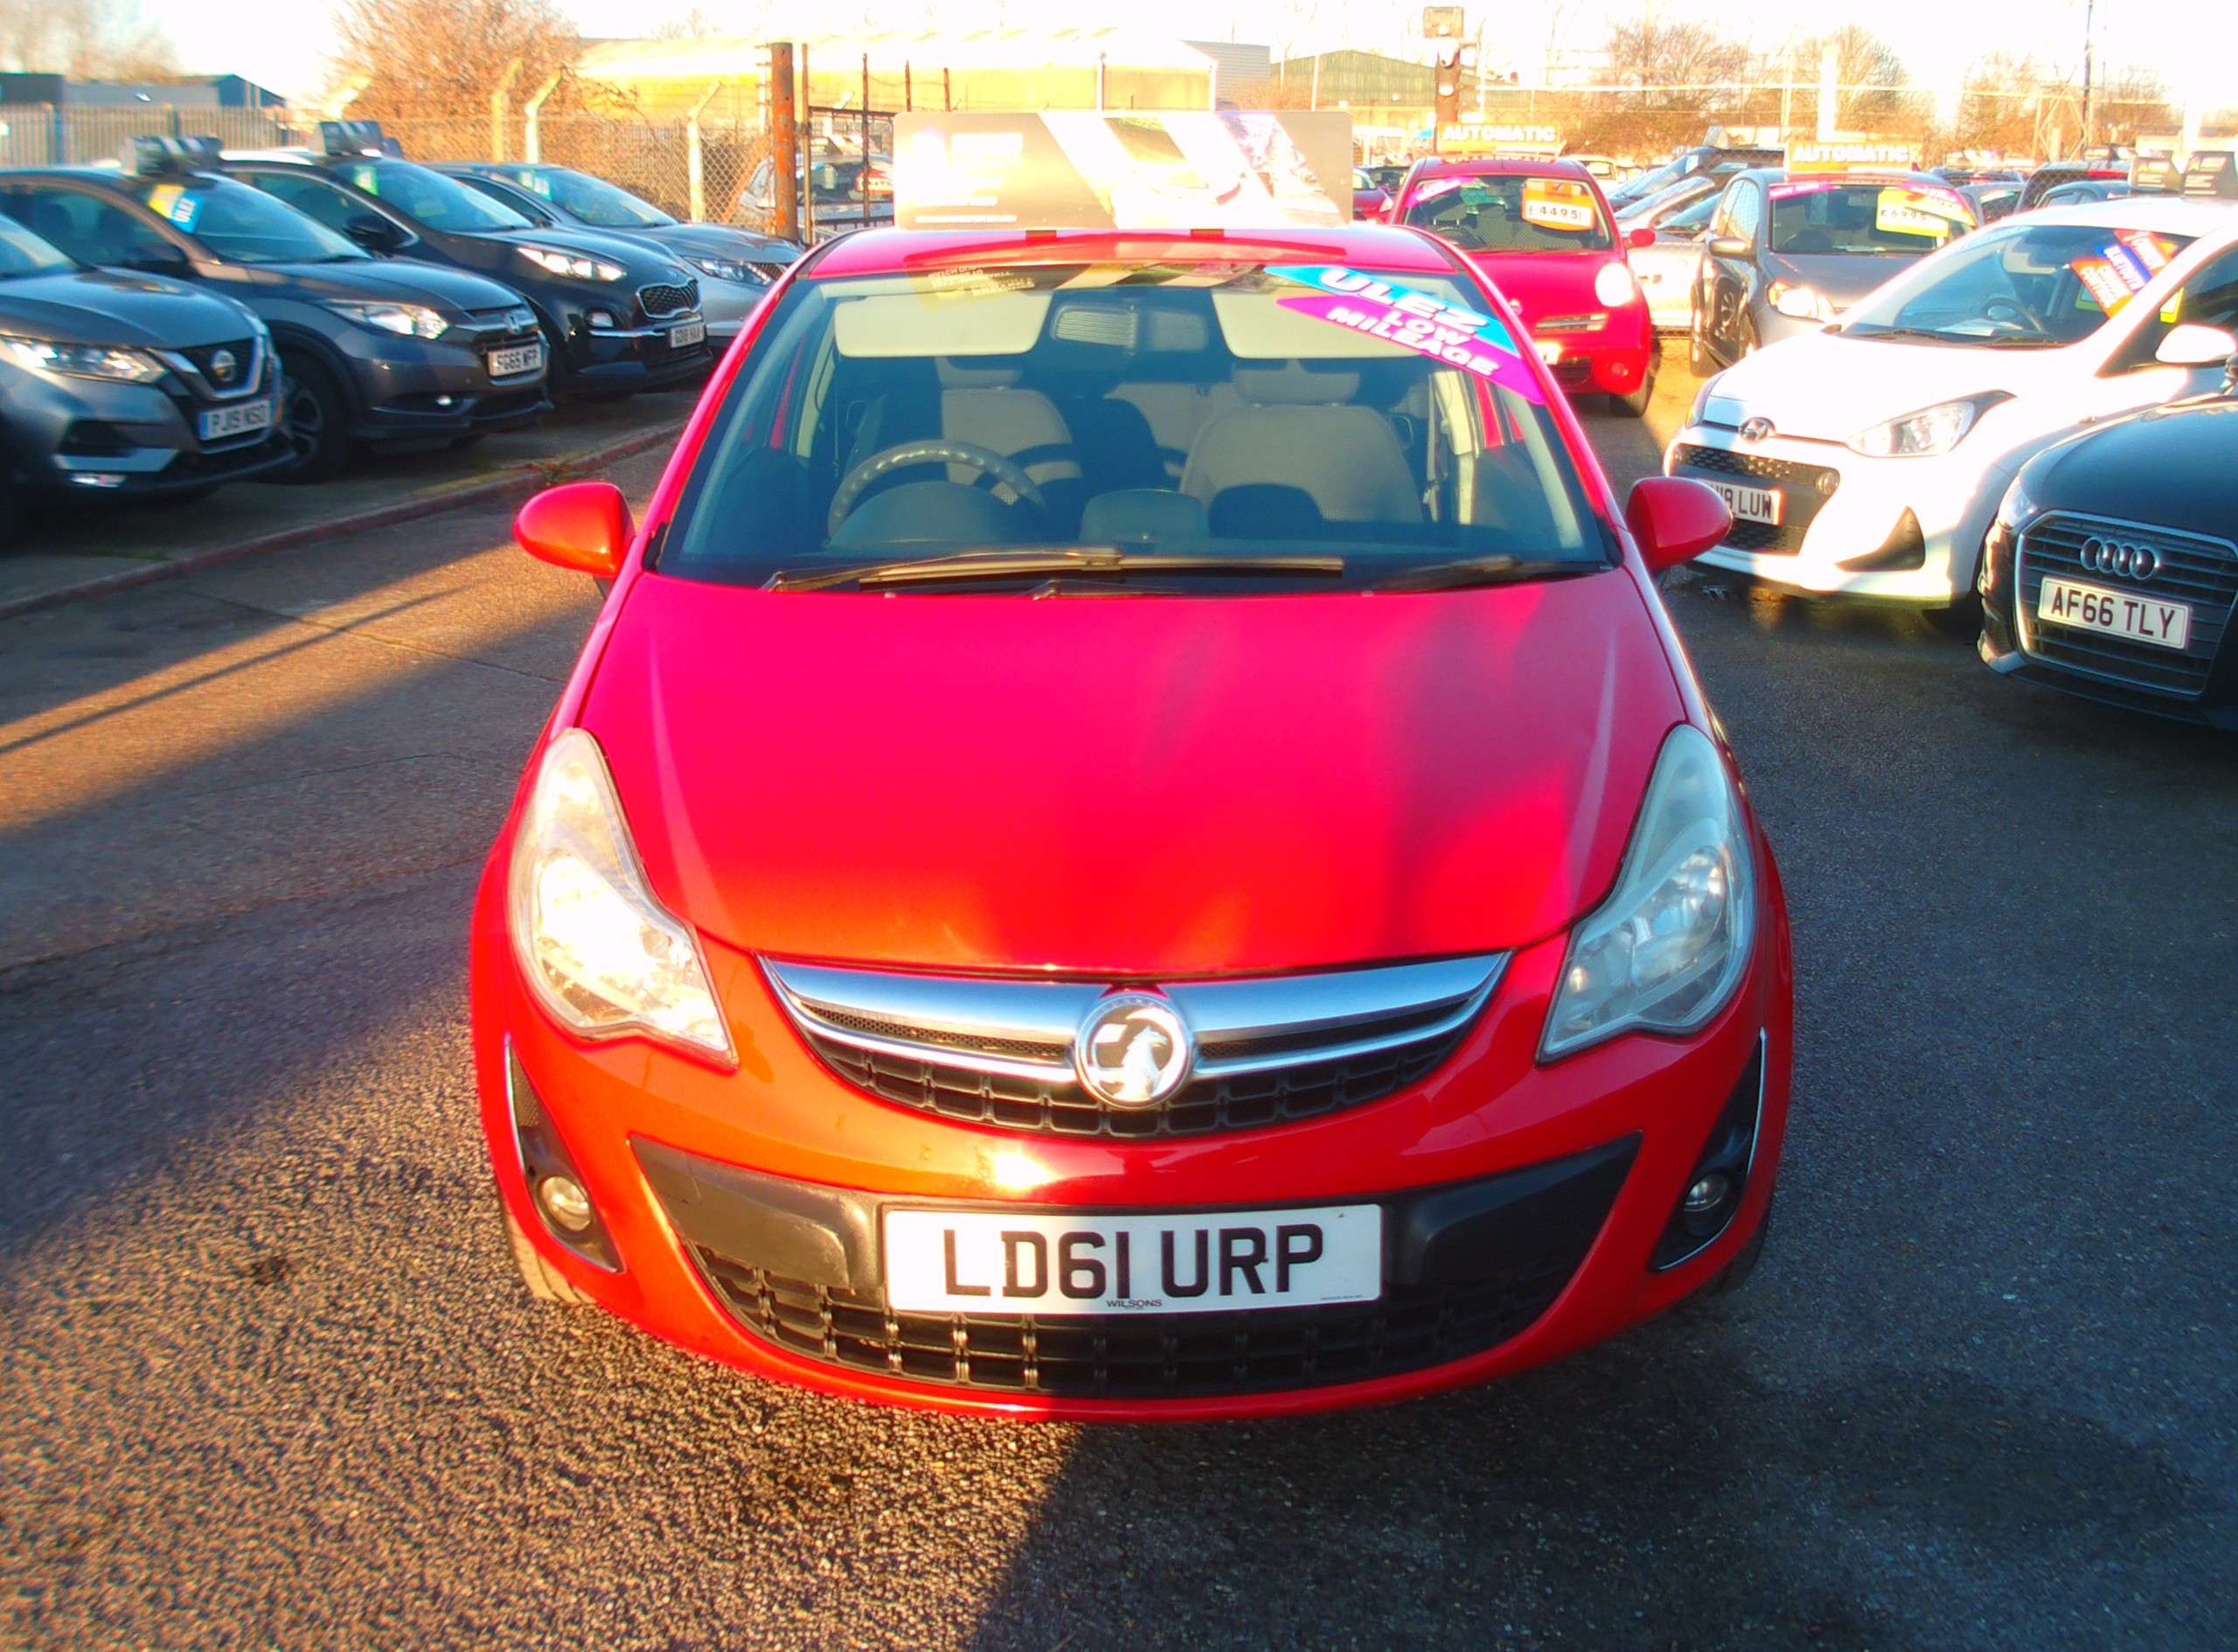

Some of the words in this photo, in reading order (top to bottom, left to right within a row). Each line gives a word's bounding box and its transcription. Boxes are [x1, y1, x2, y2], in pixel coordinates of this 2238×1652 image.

[1443, 125, 1556, 142] AUTOMATIC
[1792, 145, 1909, 163] AUTOMATIC
[1319, 268, 1489, 336] ULEZ
[1325, 308, 1500, 376] MILEAGE
[1383, 311, 1471, 346] LOW
[1738, 489, 1772, 518] LUW
[2050, 585, 2116, 628] AF66
[2124, 599, 2176, 640] TLY
[943, 1229, 1130, 1300] LD61
[1160, 1223, 1324, 1298] URP
[1106, 1299, 1163, 1308] WILSONS
